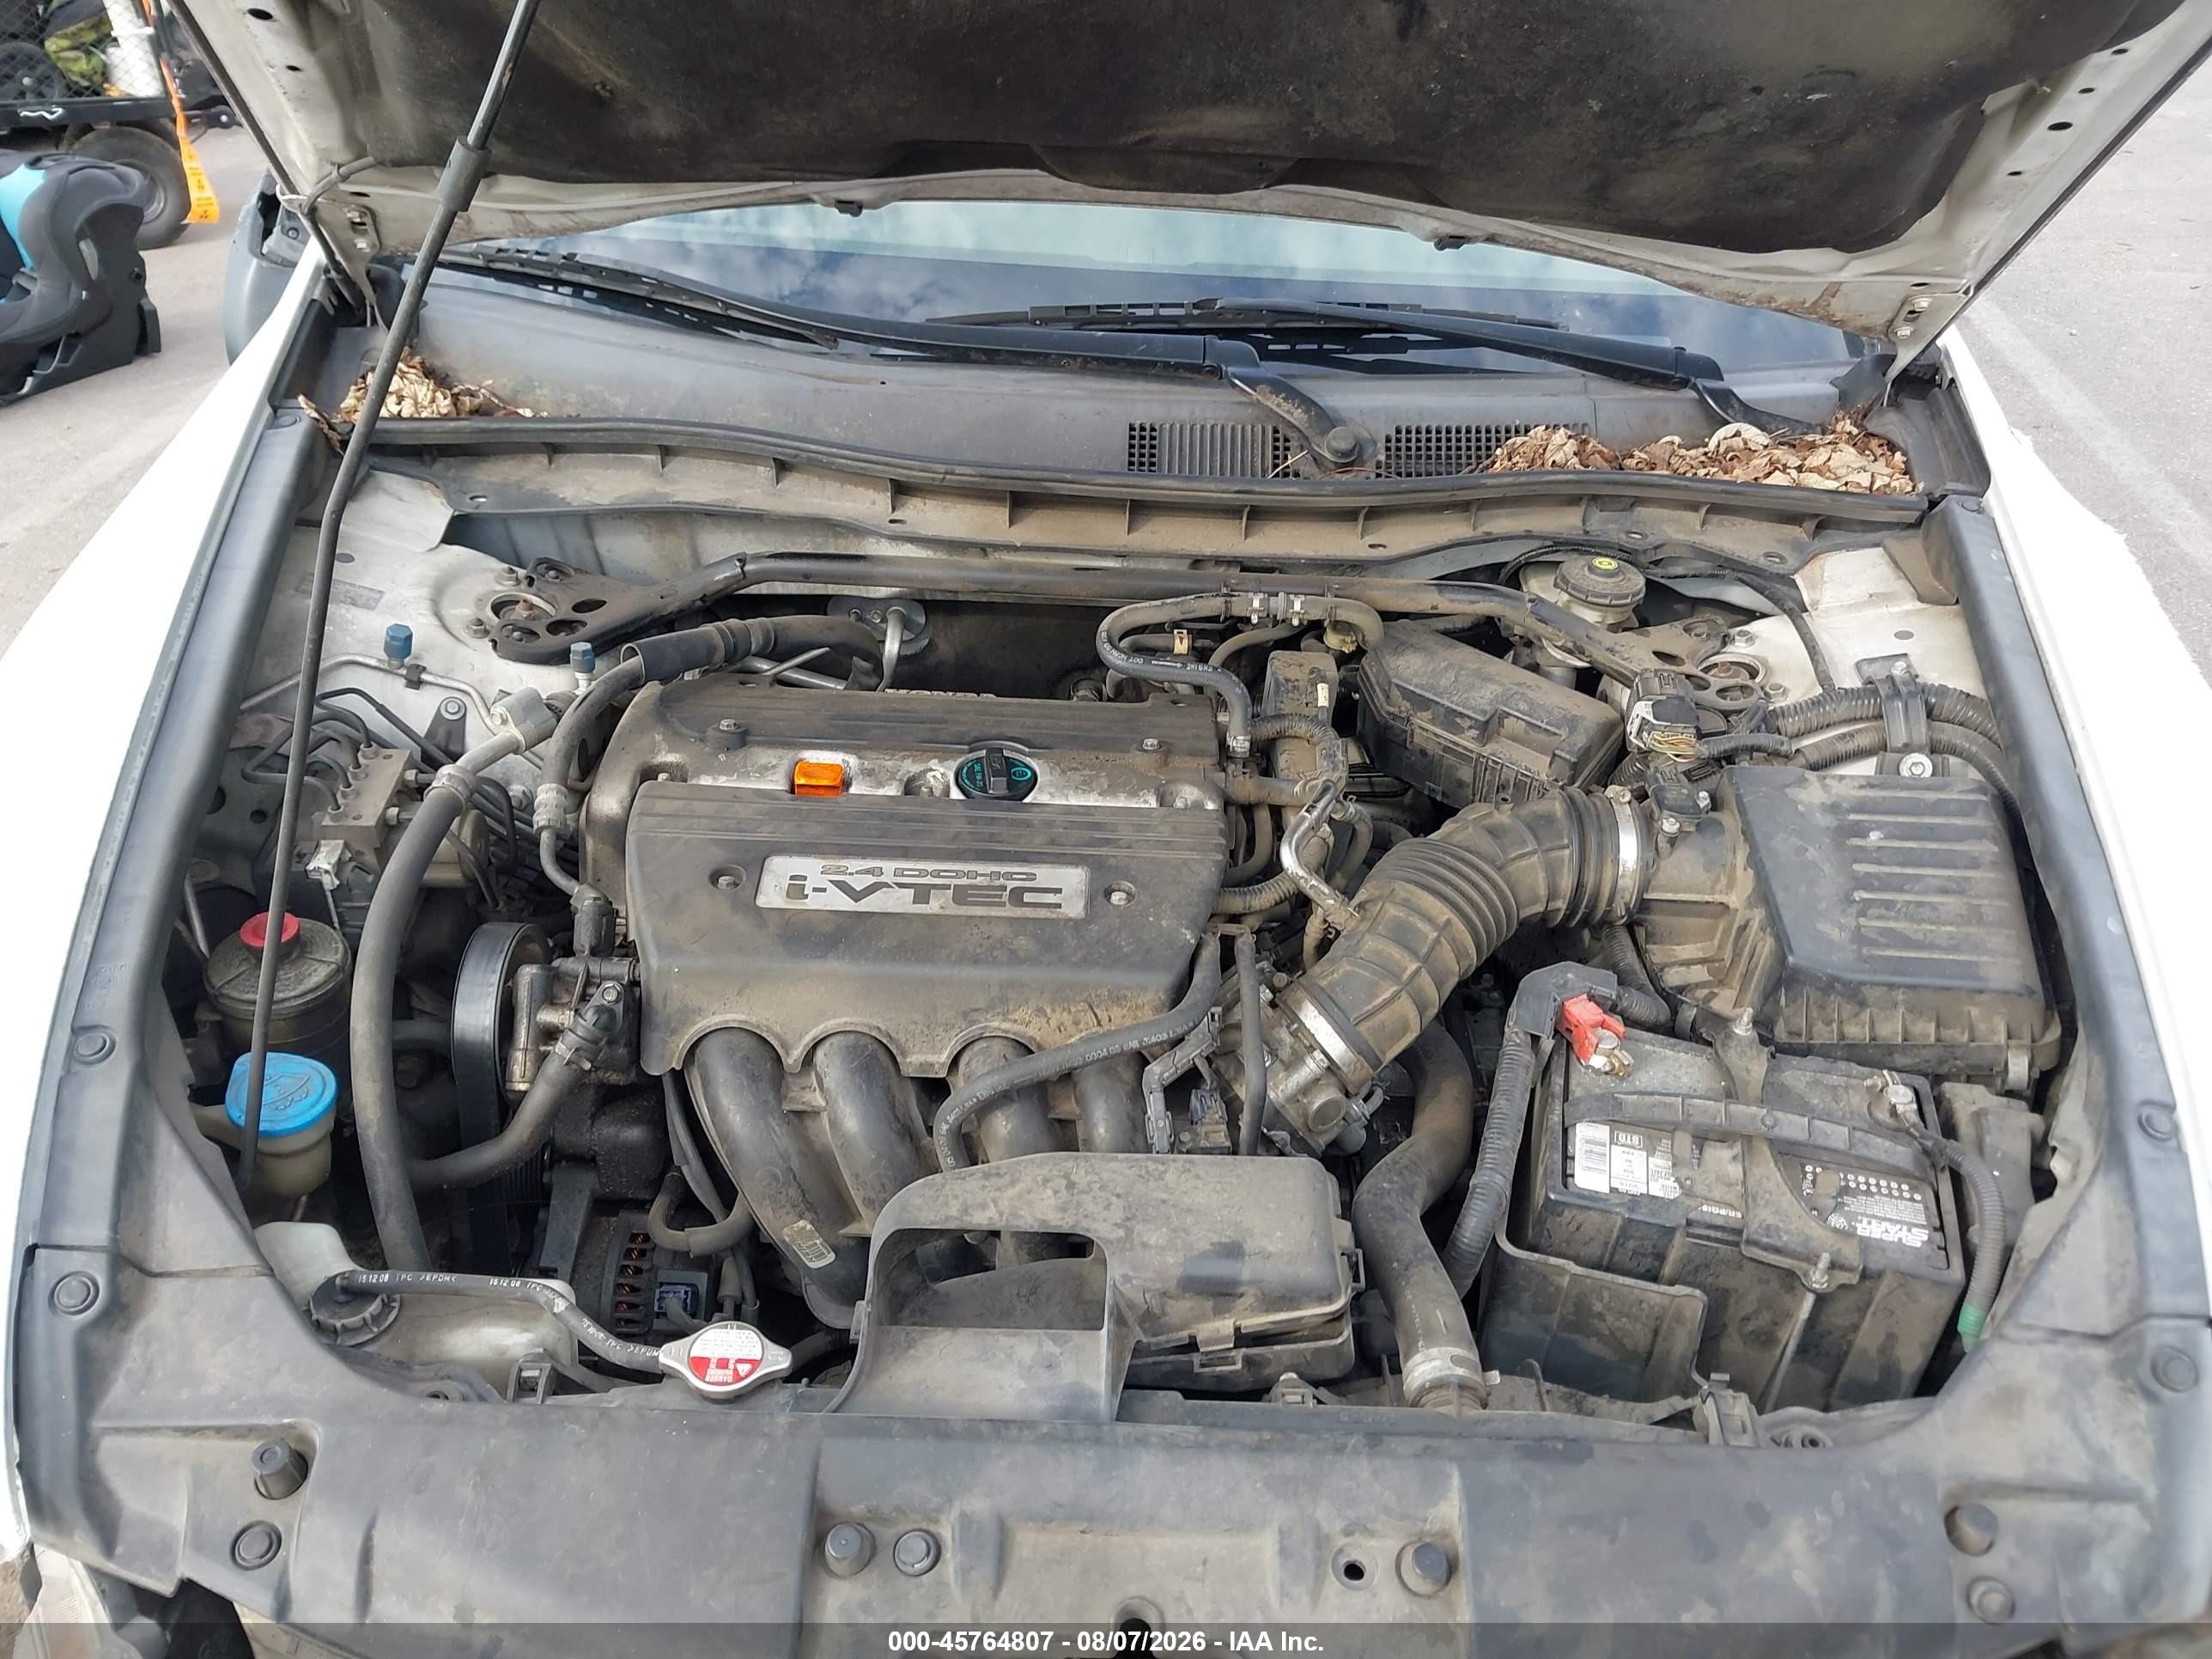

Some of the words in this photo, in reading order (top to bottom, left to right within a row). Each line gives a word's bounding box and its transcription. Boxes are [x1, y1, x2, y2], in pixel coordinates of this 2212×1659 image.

[819, 864, 884, 878] 2.4
[893, 866, 1037, 882] DOHC
[785, 874, 1062, 909] i-VTEC
[1856, 1218, 1929, 1242] START
[1856, 1223, 1923, 1248] SUPER
